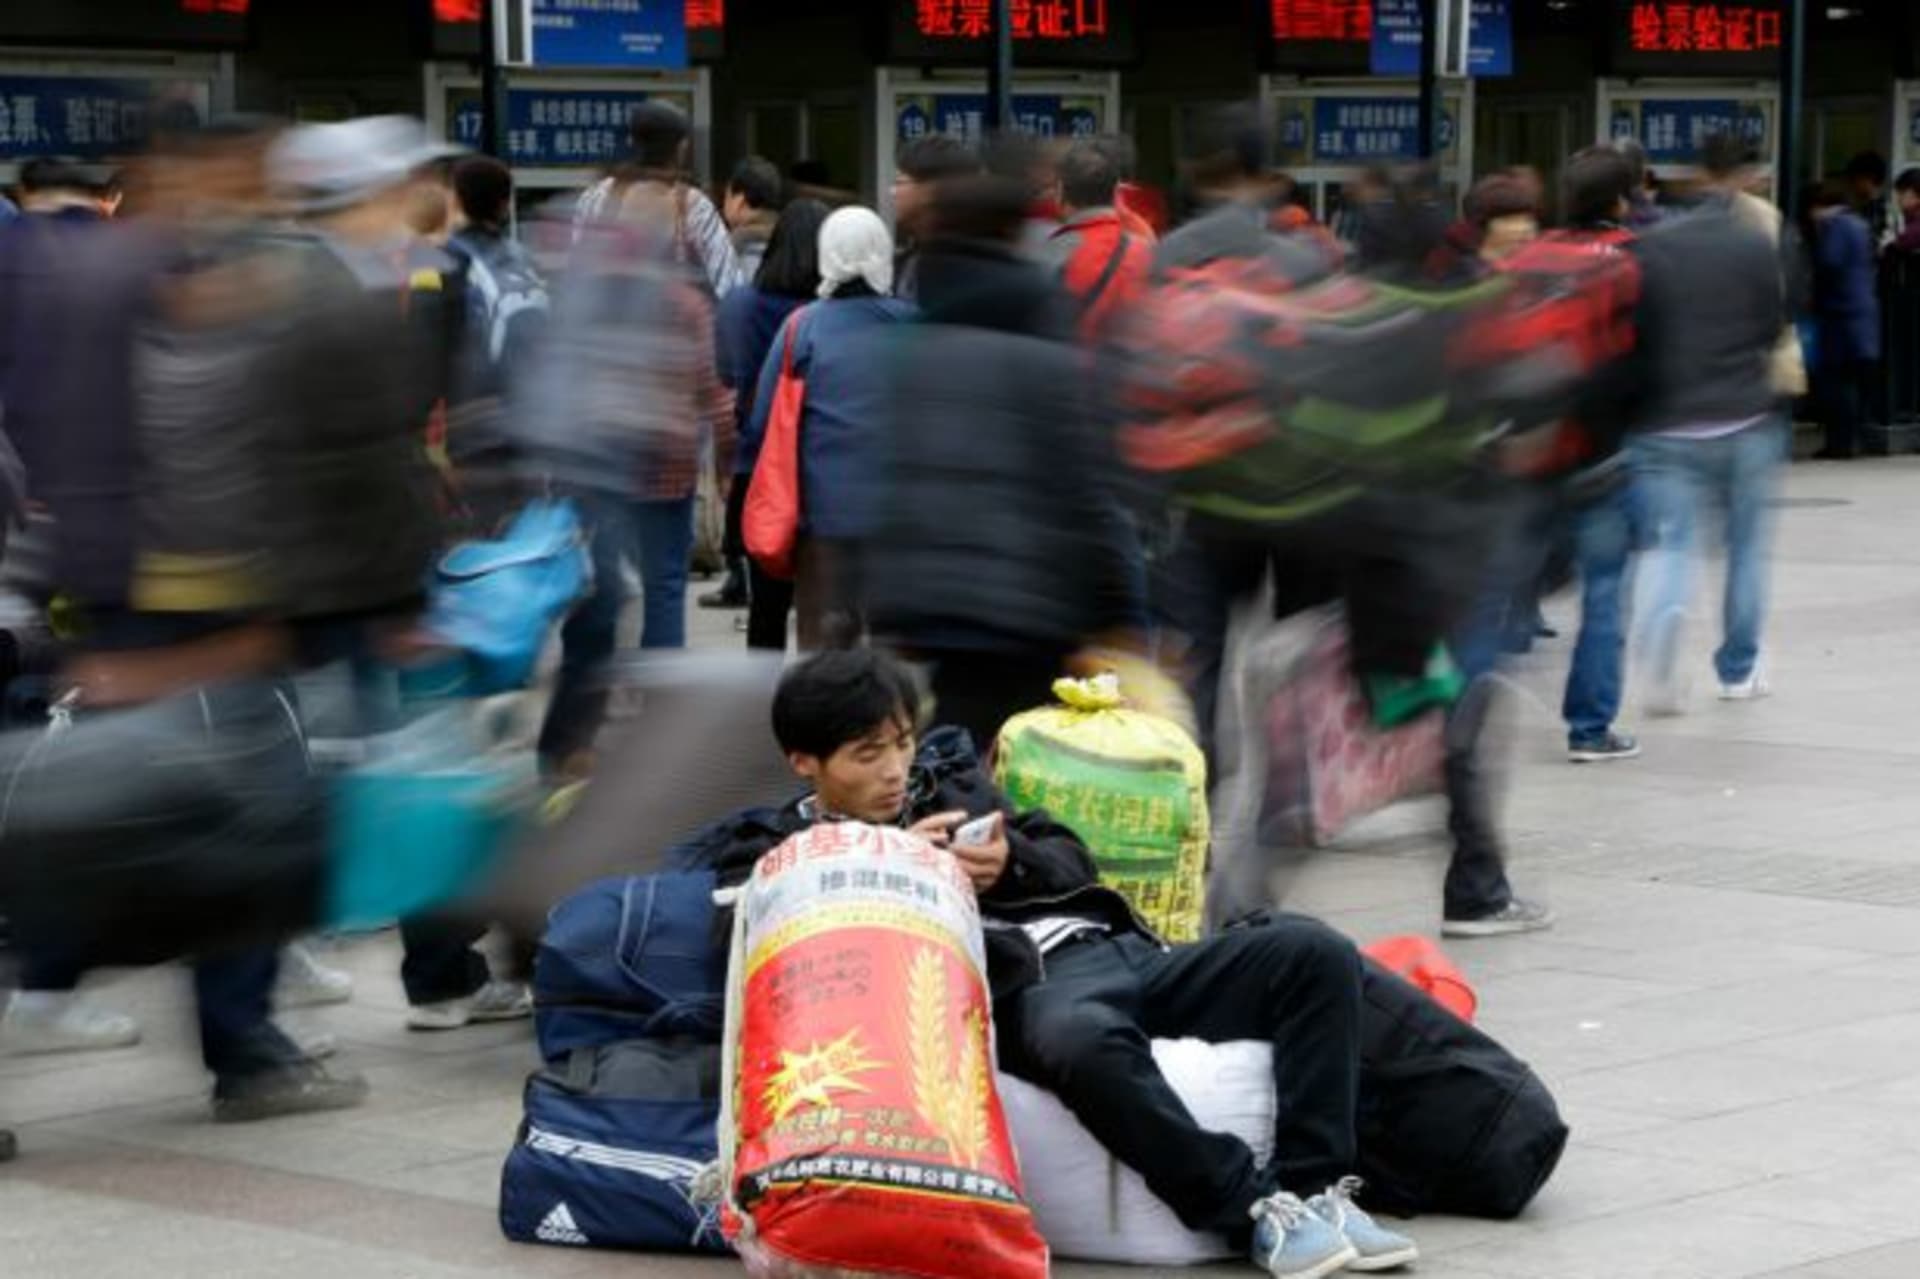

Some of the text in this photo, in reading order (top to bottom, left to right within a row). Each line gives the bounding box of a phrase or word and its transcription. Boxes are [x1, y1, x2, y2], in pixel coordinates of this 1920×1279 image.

[1632, 3, 1781, 50] 验票验证口
